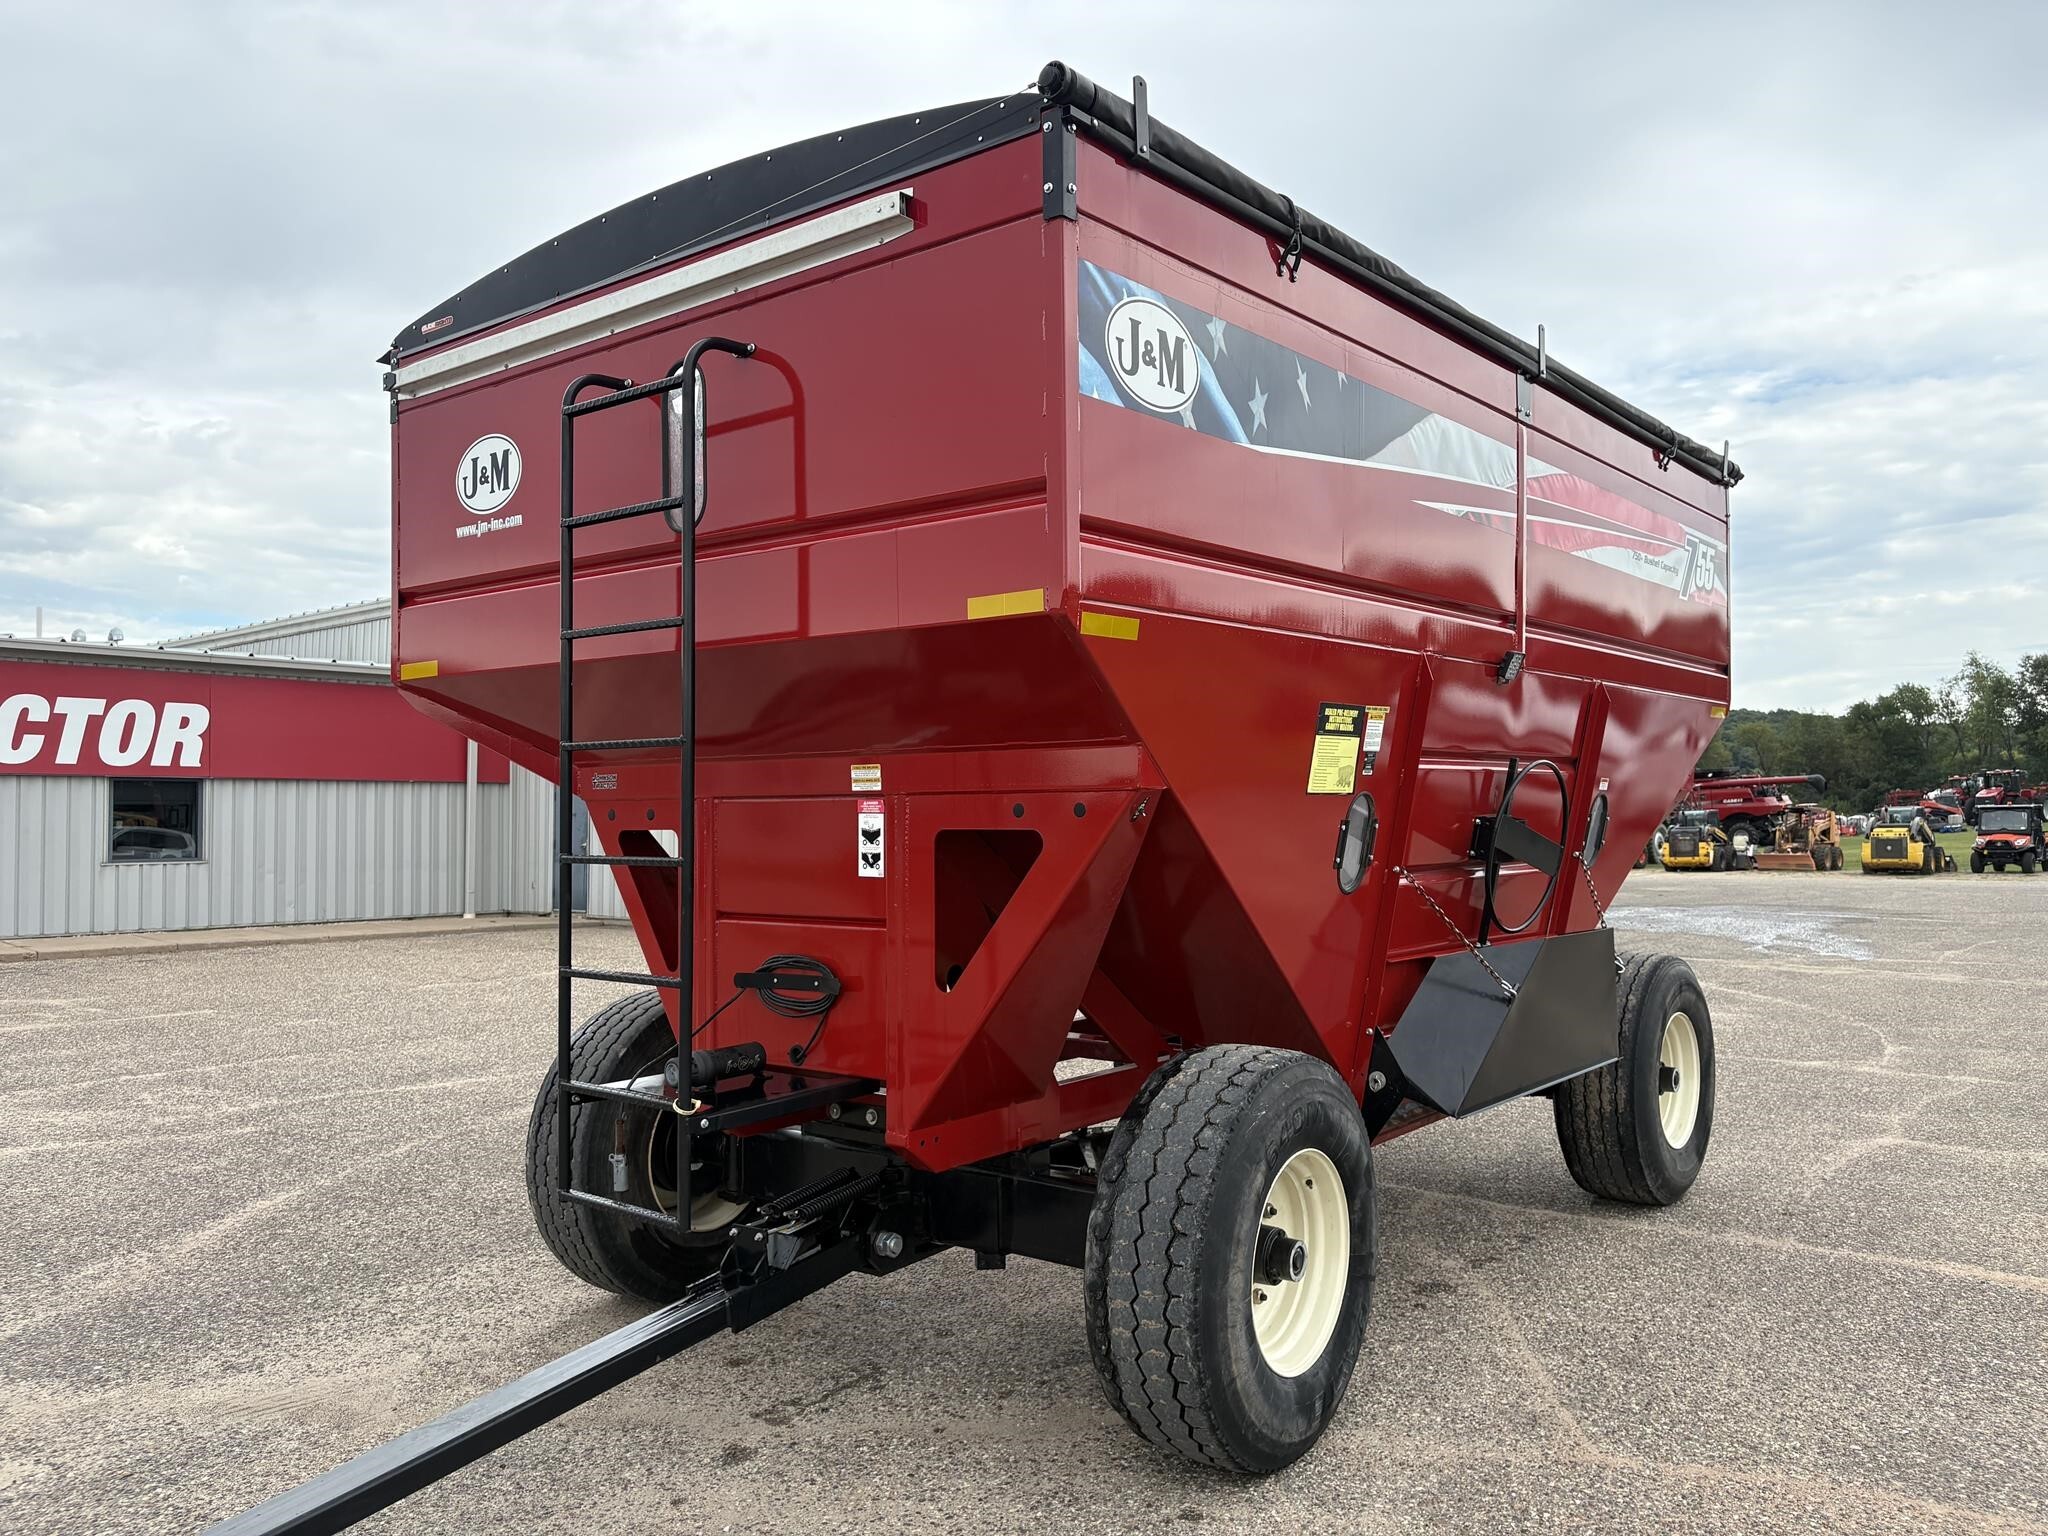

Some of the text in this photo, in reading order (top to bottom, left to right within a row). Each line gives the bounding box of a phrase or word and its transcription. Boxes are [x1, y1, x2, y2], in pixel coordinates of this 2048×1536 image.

[1115, 317, 1187, 395] J&M
[462, 448, 511, 500] J&M
[456, 514, 523, 538] www.jm-inc.com
[1643, 555, 1660, 568] Bushel
[1660, 560, 1679, 577] Capacity
[1679, 536, 1715, 600] 755
[0, 693, 210, 768] CTOR
